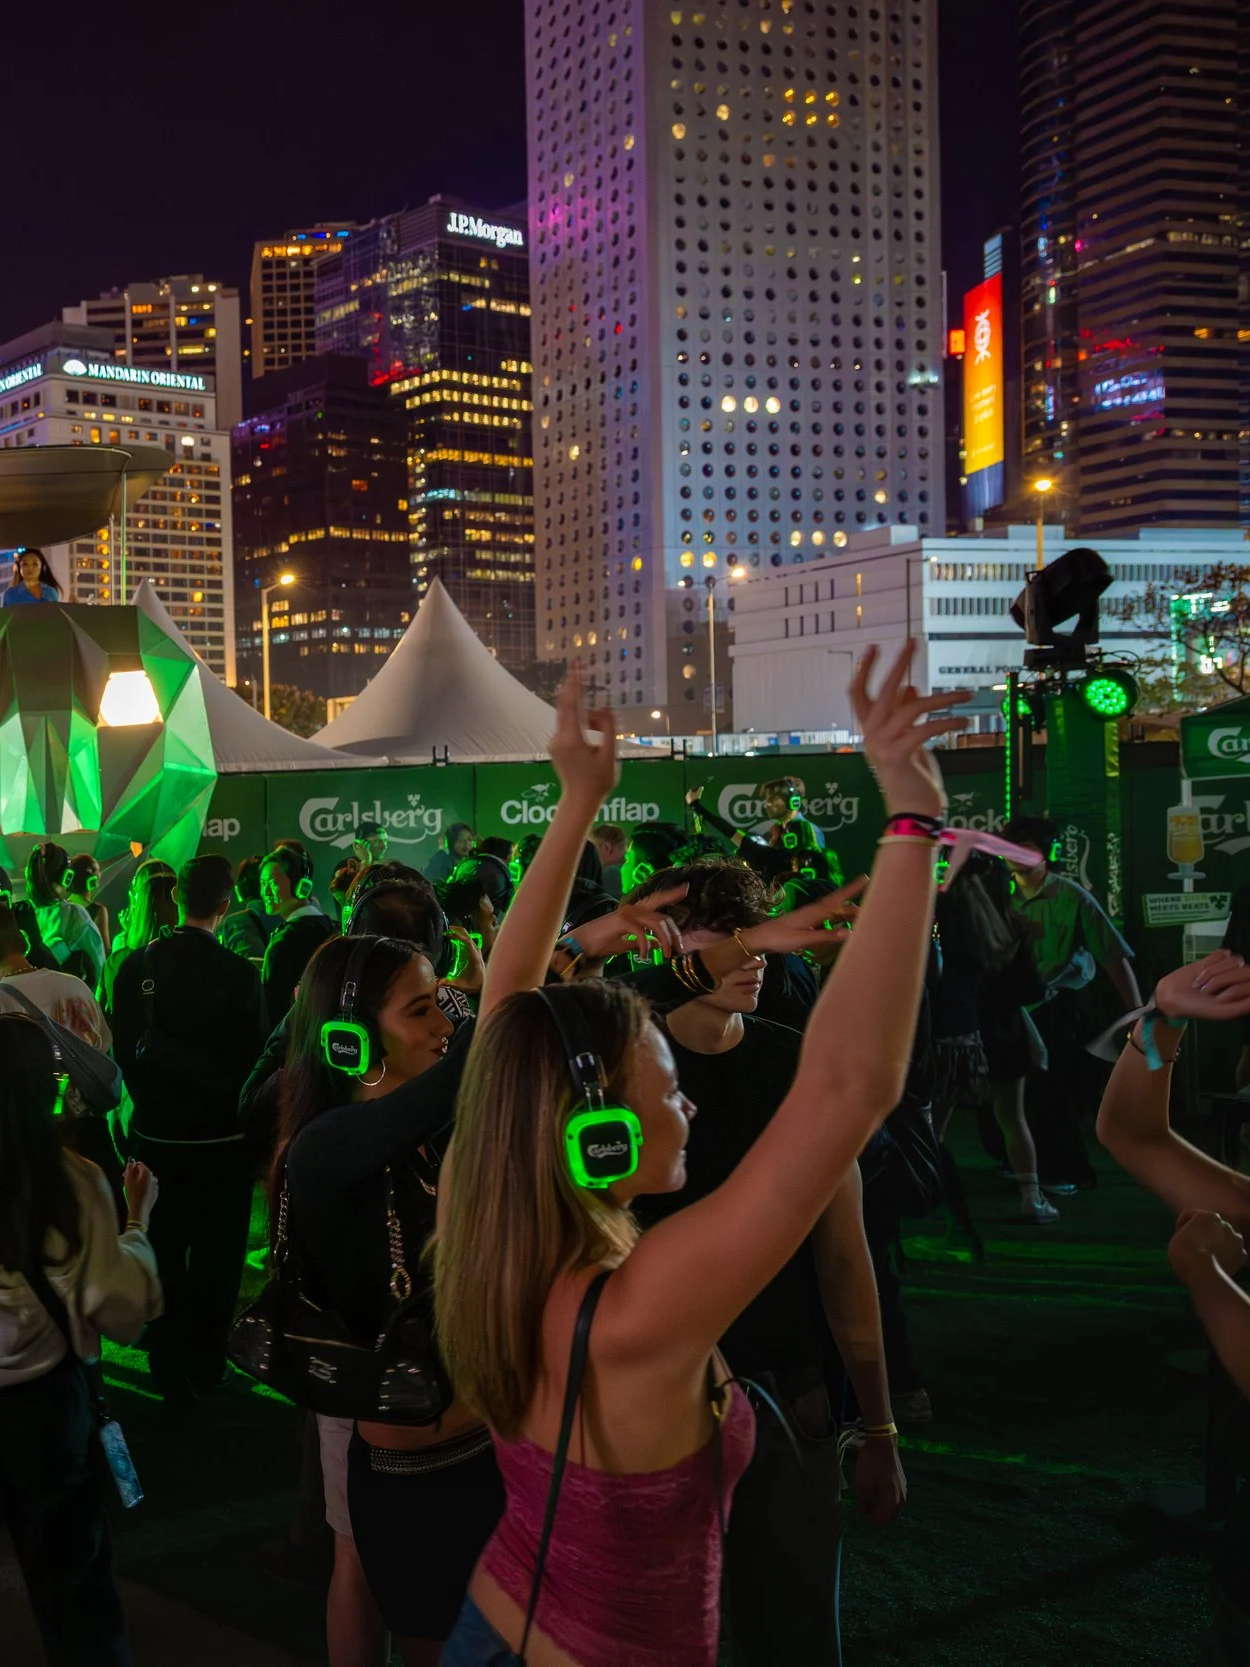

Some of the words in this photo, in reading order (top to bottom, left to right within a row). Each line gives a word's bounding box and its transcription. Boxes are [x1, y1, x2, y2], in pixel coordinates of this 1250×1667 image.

[88, 363, 150, 383] MANDARIN
[150, 371, 206, 391] ORIENTAL
[939, 666, 993, 675] GENERAL
[299, 797, 443, 849] Carlsberg
[500, 798, 660, 824] Clocnflap
